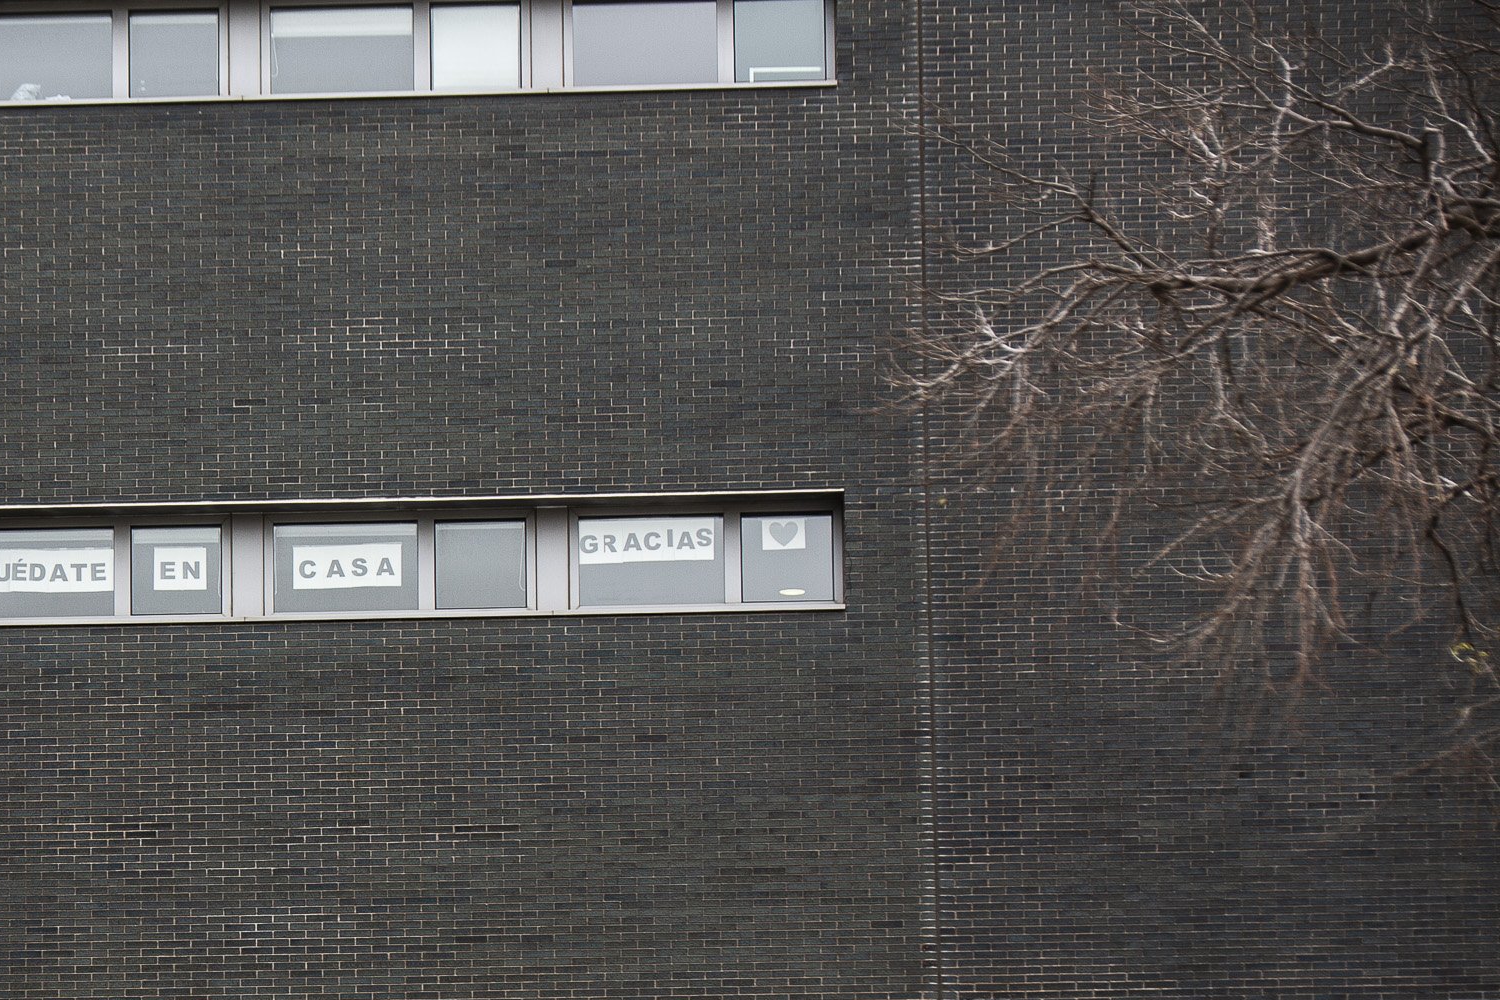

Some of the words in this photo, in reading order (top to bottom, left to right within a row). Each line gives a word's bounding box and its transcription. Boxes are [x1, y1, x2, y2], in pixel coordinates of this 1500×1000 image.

[160, 561, 200, 580] EN
[298, 557, 395, 579] CASA
[579, 527, 713, 554] GRACIAS
